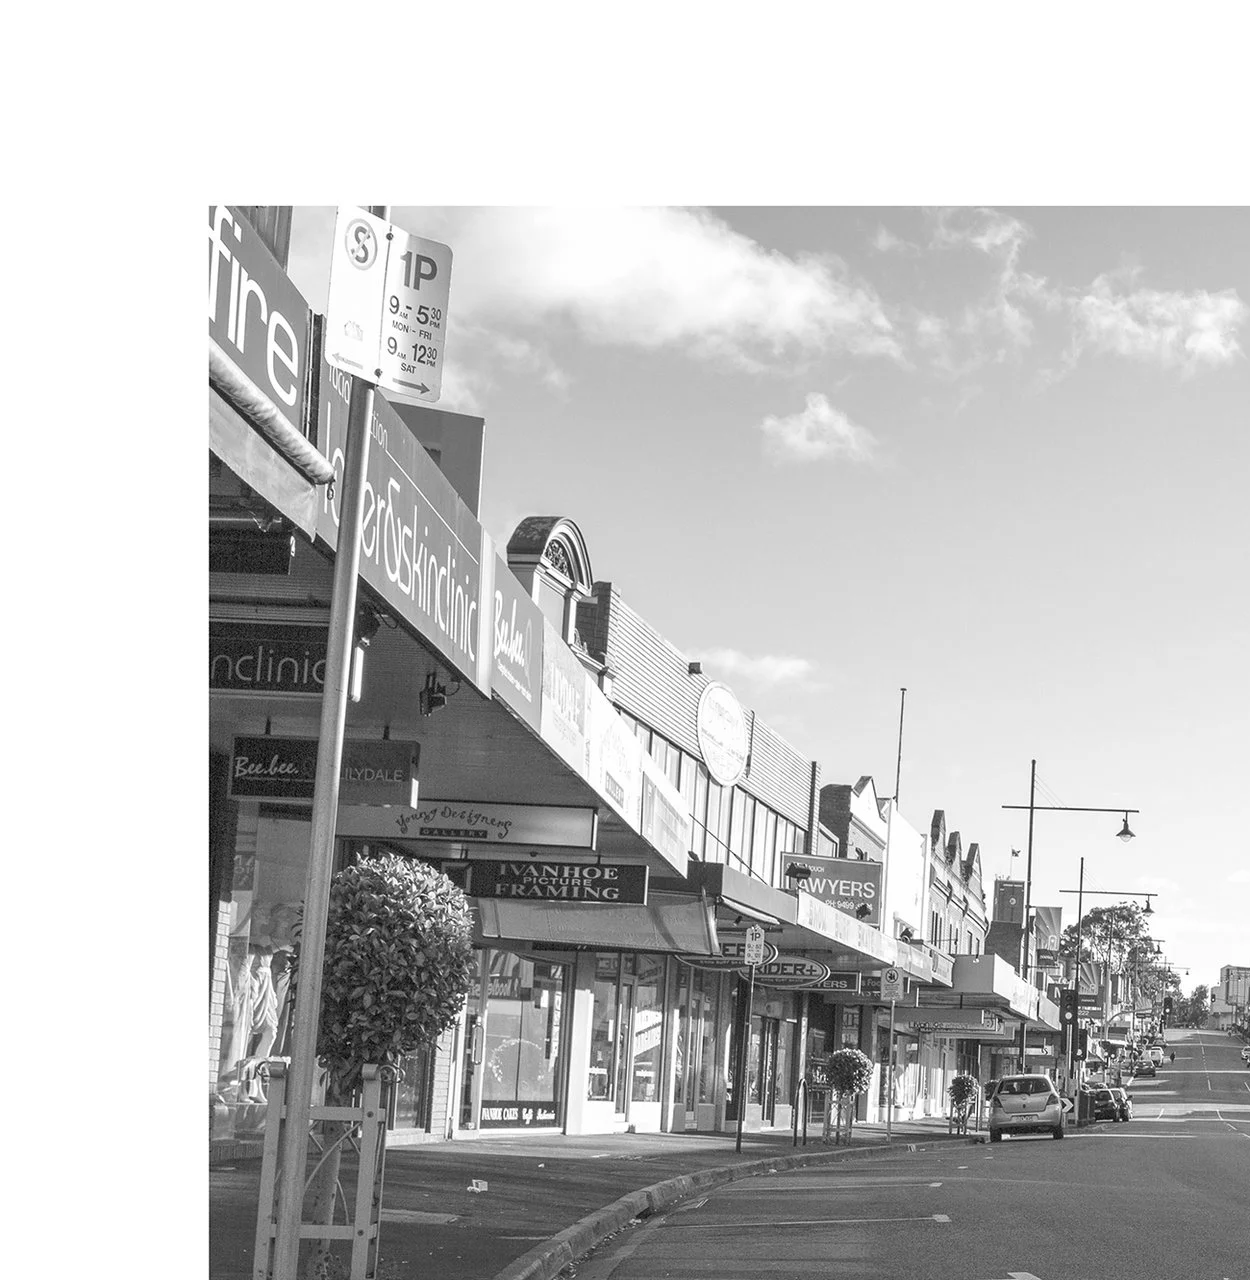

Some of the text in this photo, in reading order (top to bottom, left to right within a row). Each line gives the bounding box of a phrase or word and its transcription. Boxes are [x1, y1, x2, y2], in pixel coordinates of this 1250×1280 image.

[400, 250, 438, 290] 1P
[419, 329, 432, 341] FRI
[400, 363, 416, 374] SAT
[440, 805, 513, 839] Designers
[421, 828, 486, 837] GALLERY
[500, 864, 619, 880] IVANHOE
[523, 877, 593, 887] PICTURE
[495, 884, 620, 900] FRAMING
